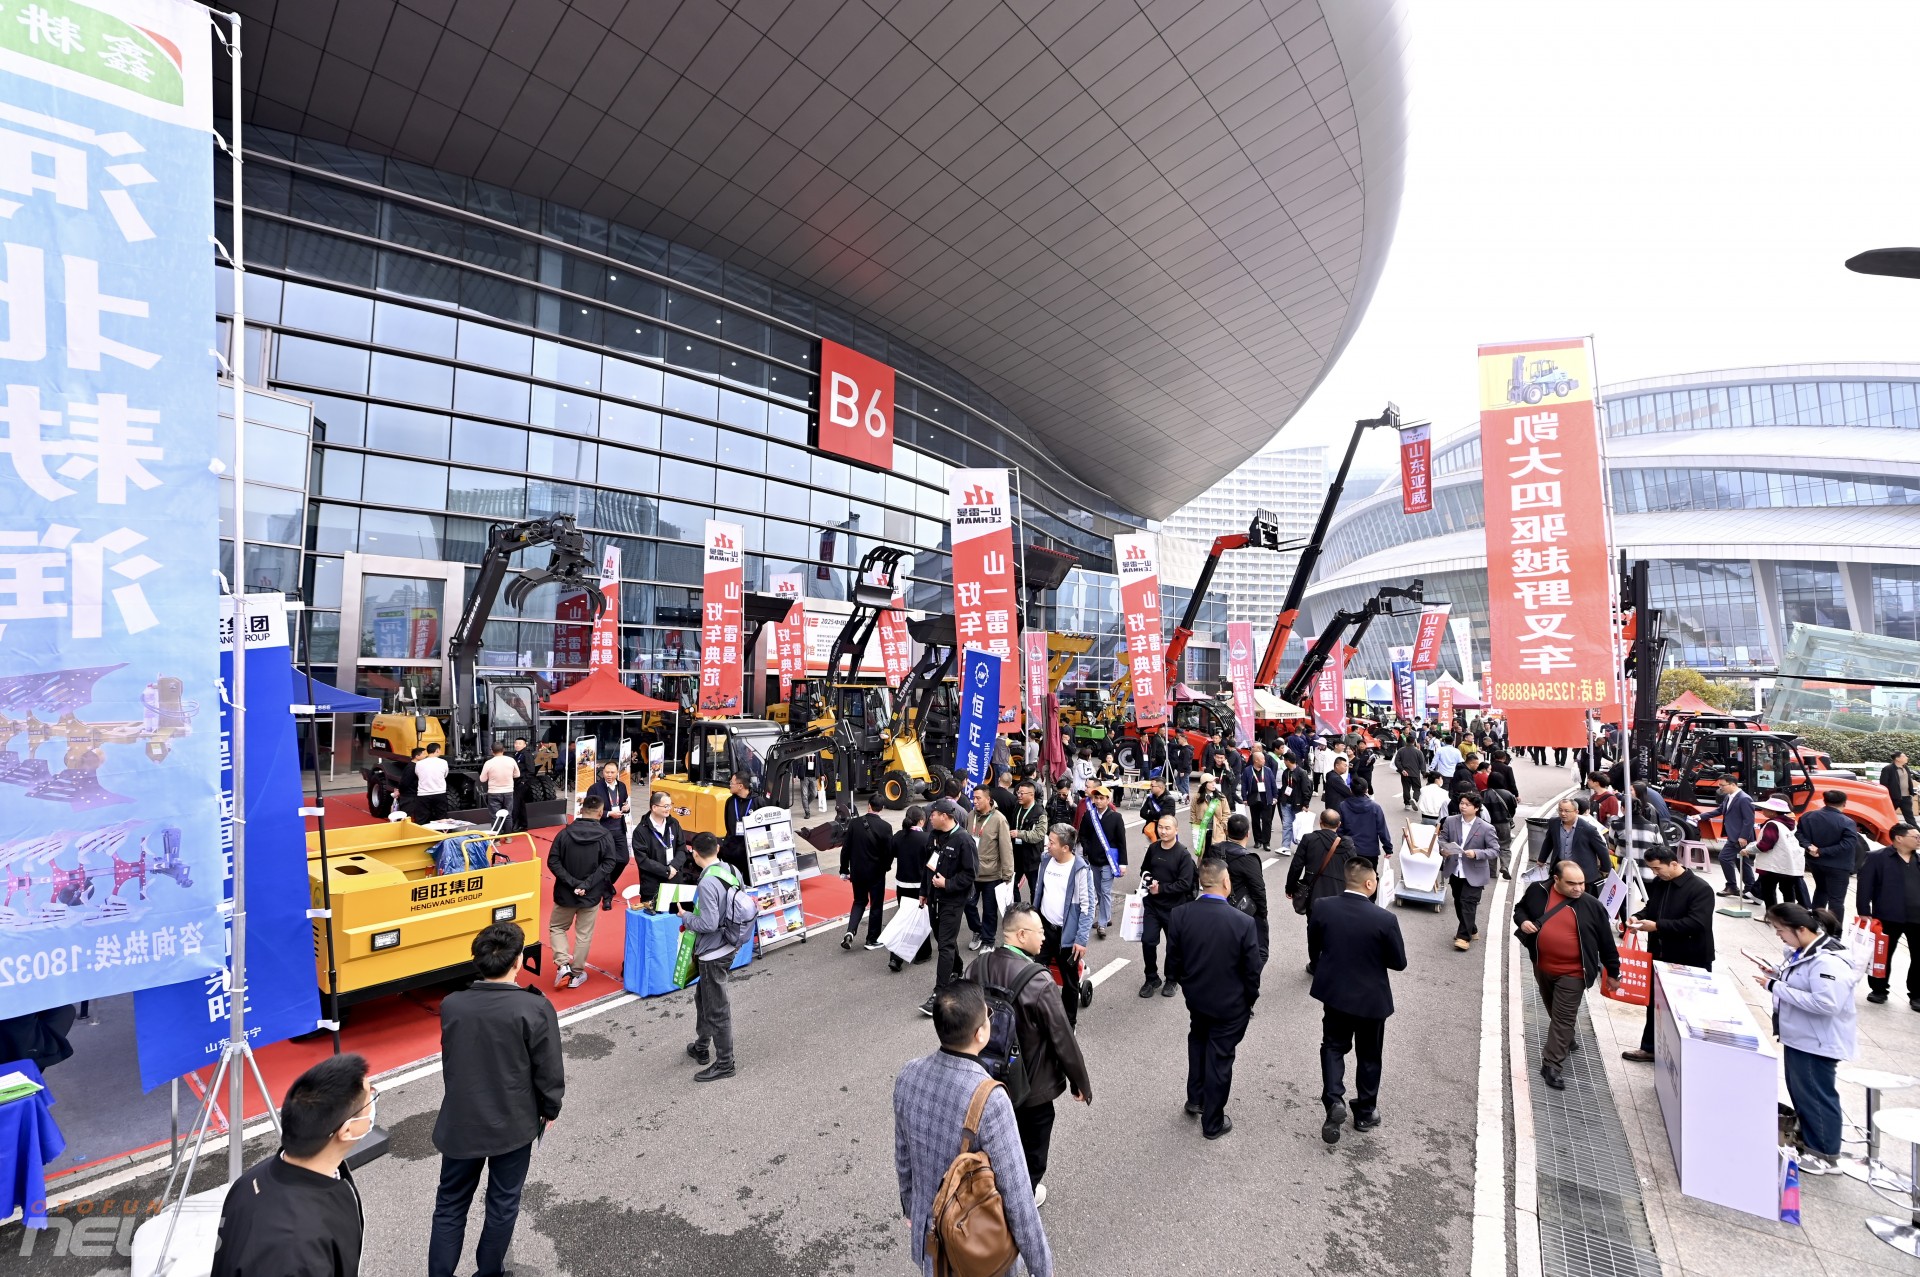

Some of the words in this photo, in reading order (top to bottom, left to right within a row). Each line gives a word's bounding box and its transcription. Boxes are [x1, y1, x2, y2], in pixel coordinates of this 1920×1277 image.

[830, 371, 886, 438] B6
[1409, 443, 1427, 506] 山东亚威
[1416, 614, 1439, 664] 山东亚威
[1400, 664, 1414, 721] YAWEH
[411, 876, 484, 902] 恒旺集团
[411, 897, 456, 912] HENGWANG
[458, 892, 483, 903] GROUP
